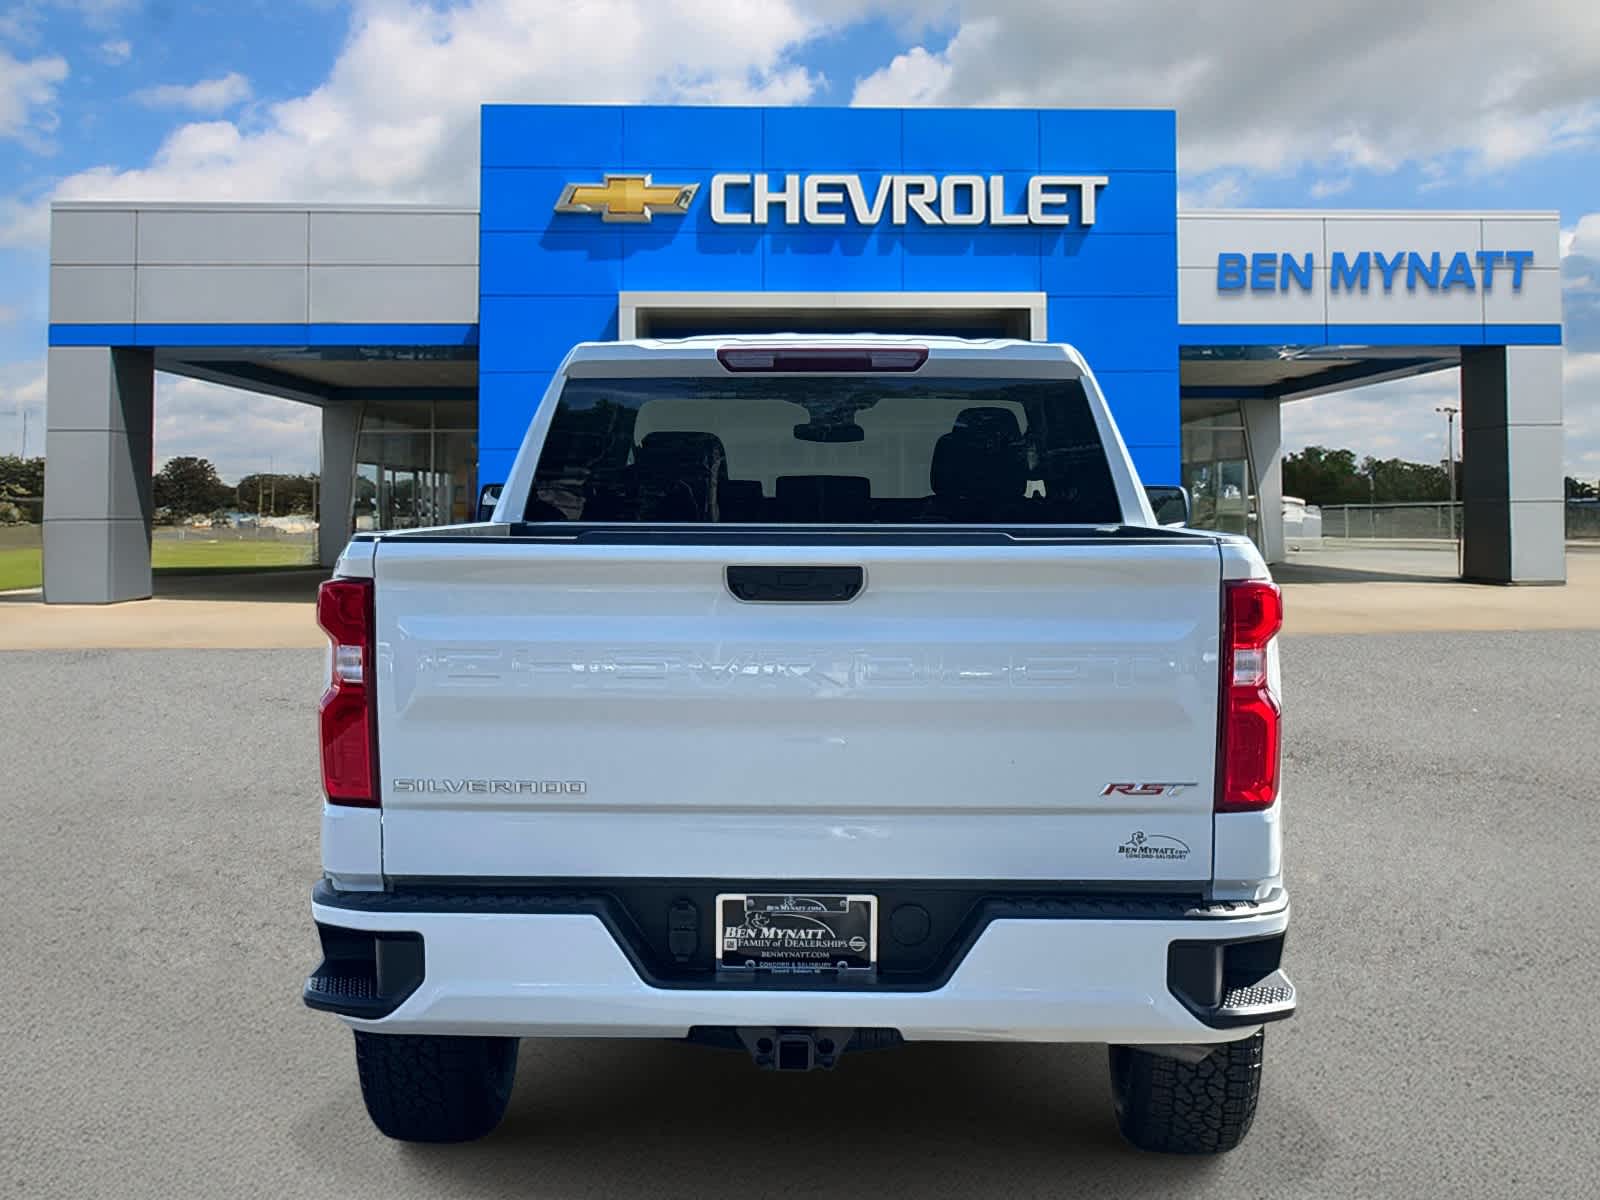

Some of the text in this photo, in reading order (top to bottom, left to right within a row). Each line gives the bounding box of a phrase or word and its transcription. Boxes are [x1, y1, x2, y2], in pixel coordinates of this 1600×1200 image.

[710, 174, 1109, 225] CHEVROLET
[1217, 251, 1534, 290] BEN MYNATT
[393, 778, 588, 793] SILVERADO
[1099, 782, 1198, 797] RST
[724, 927, 826, 939] BEN MYNATT
[738, 939, 772, 947] FAMILY
[785, 939, 848, 948] DEALERSHIPS
[761, 951, 830, 959] BENMYNATT.COM
